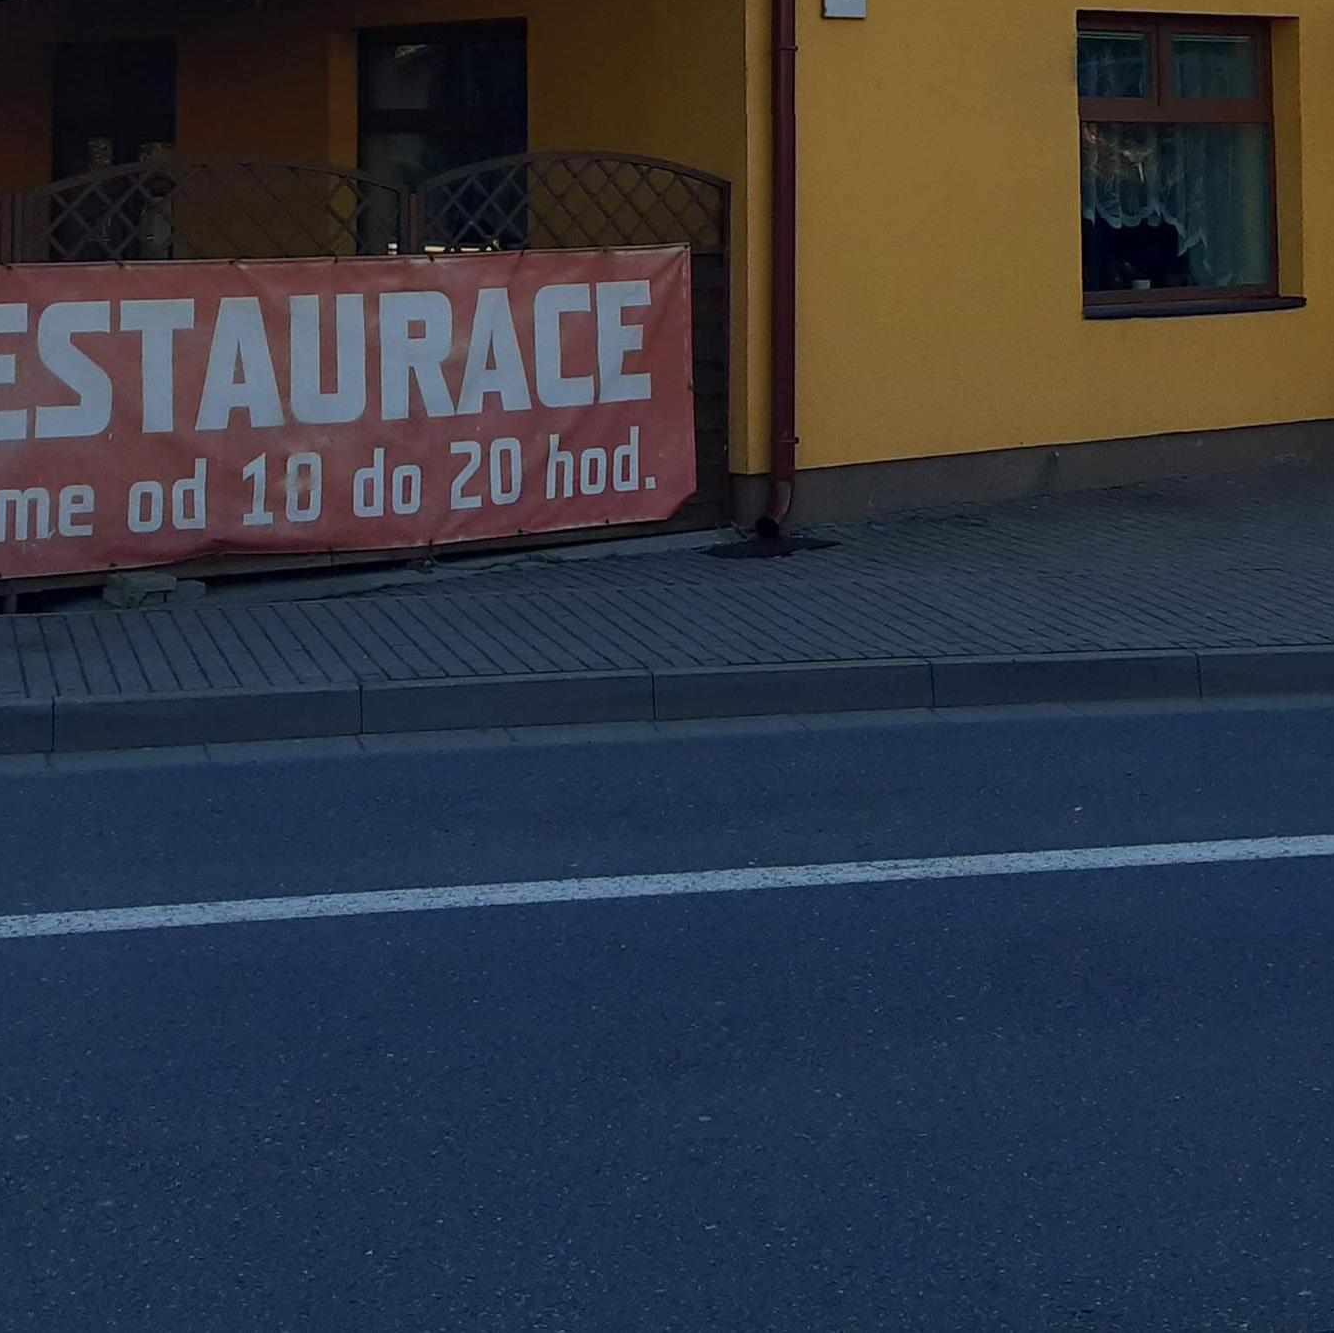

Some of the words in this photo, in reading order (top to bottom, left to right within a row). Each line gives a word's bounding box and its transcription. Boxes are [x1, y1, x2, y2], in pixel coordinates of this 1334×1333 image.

[127, 457, 208, 534] od
[242, 451, 323, 528] 10
[352, 447, 423, 519] do
[449, 436, 524, 511] 20
[545, 425, 658, 501] hod.
